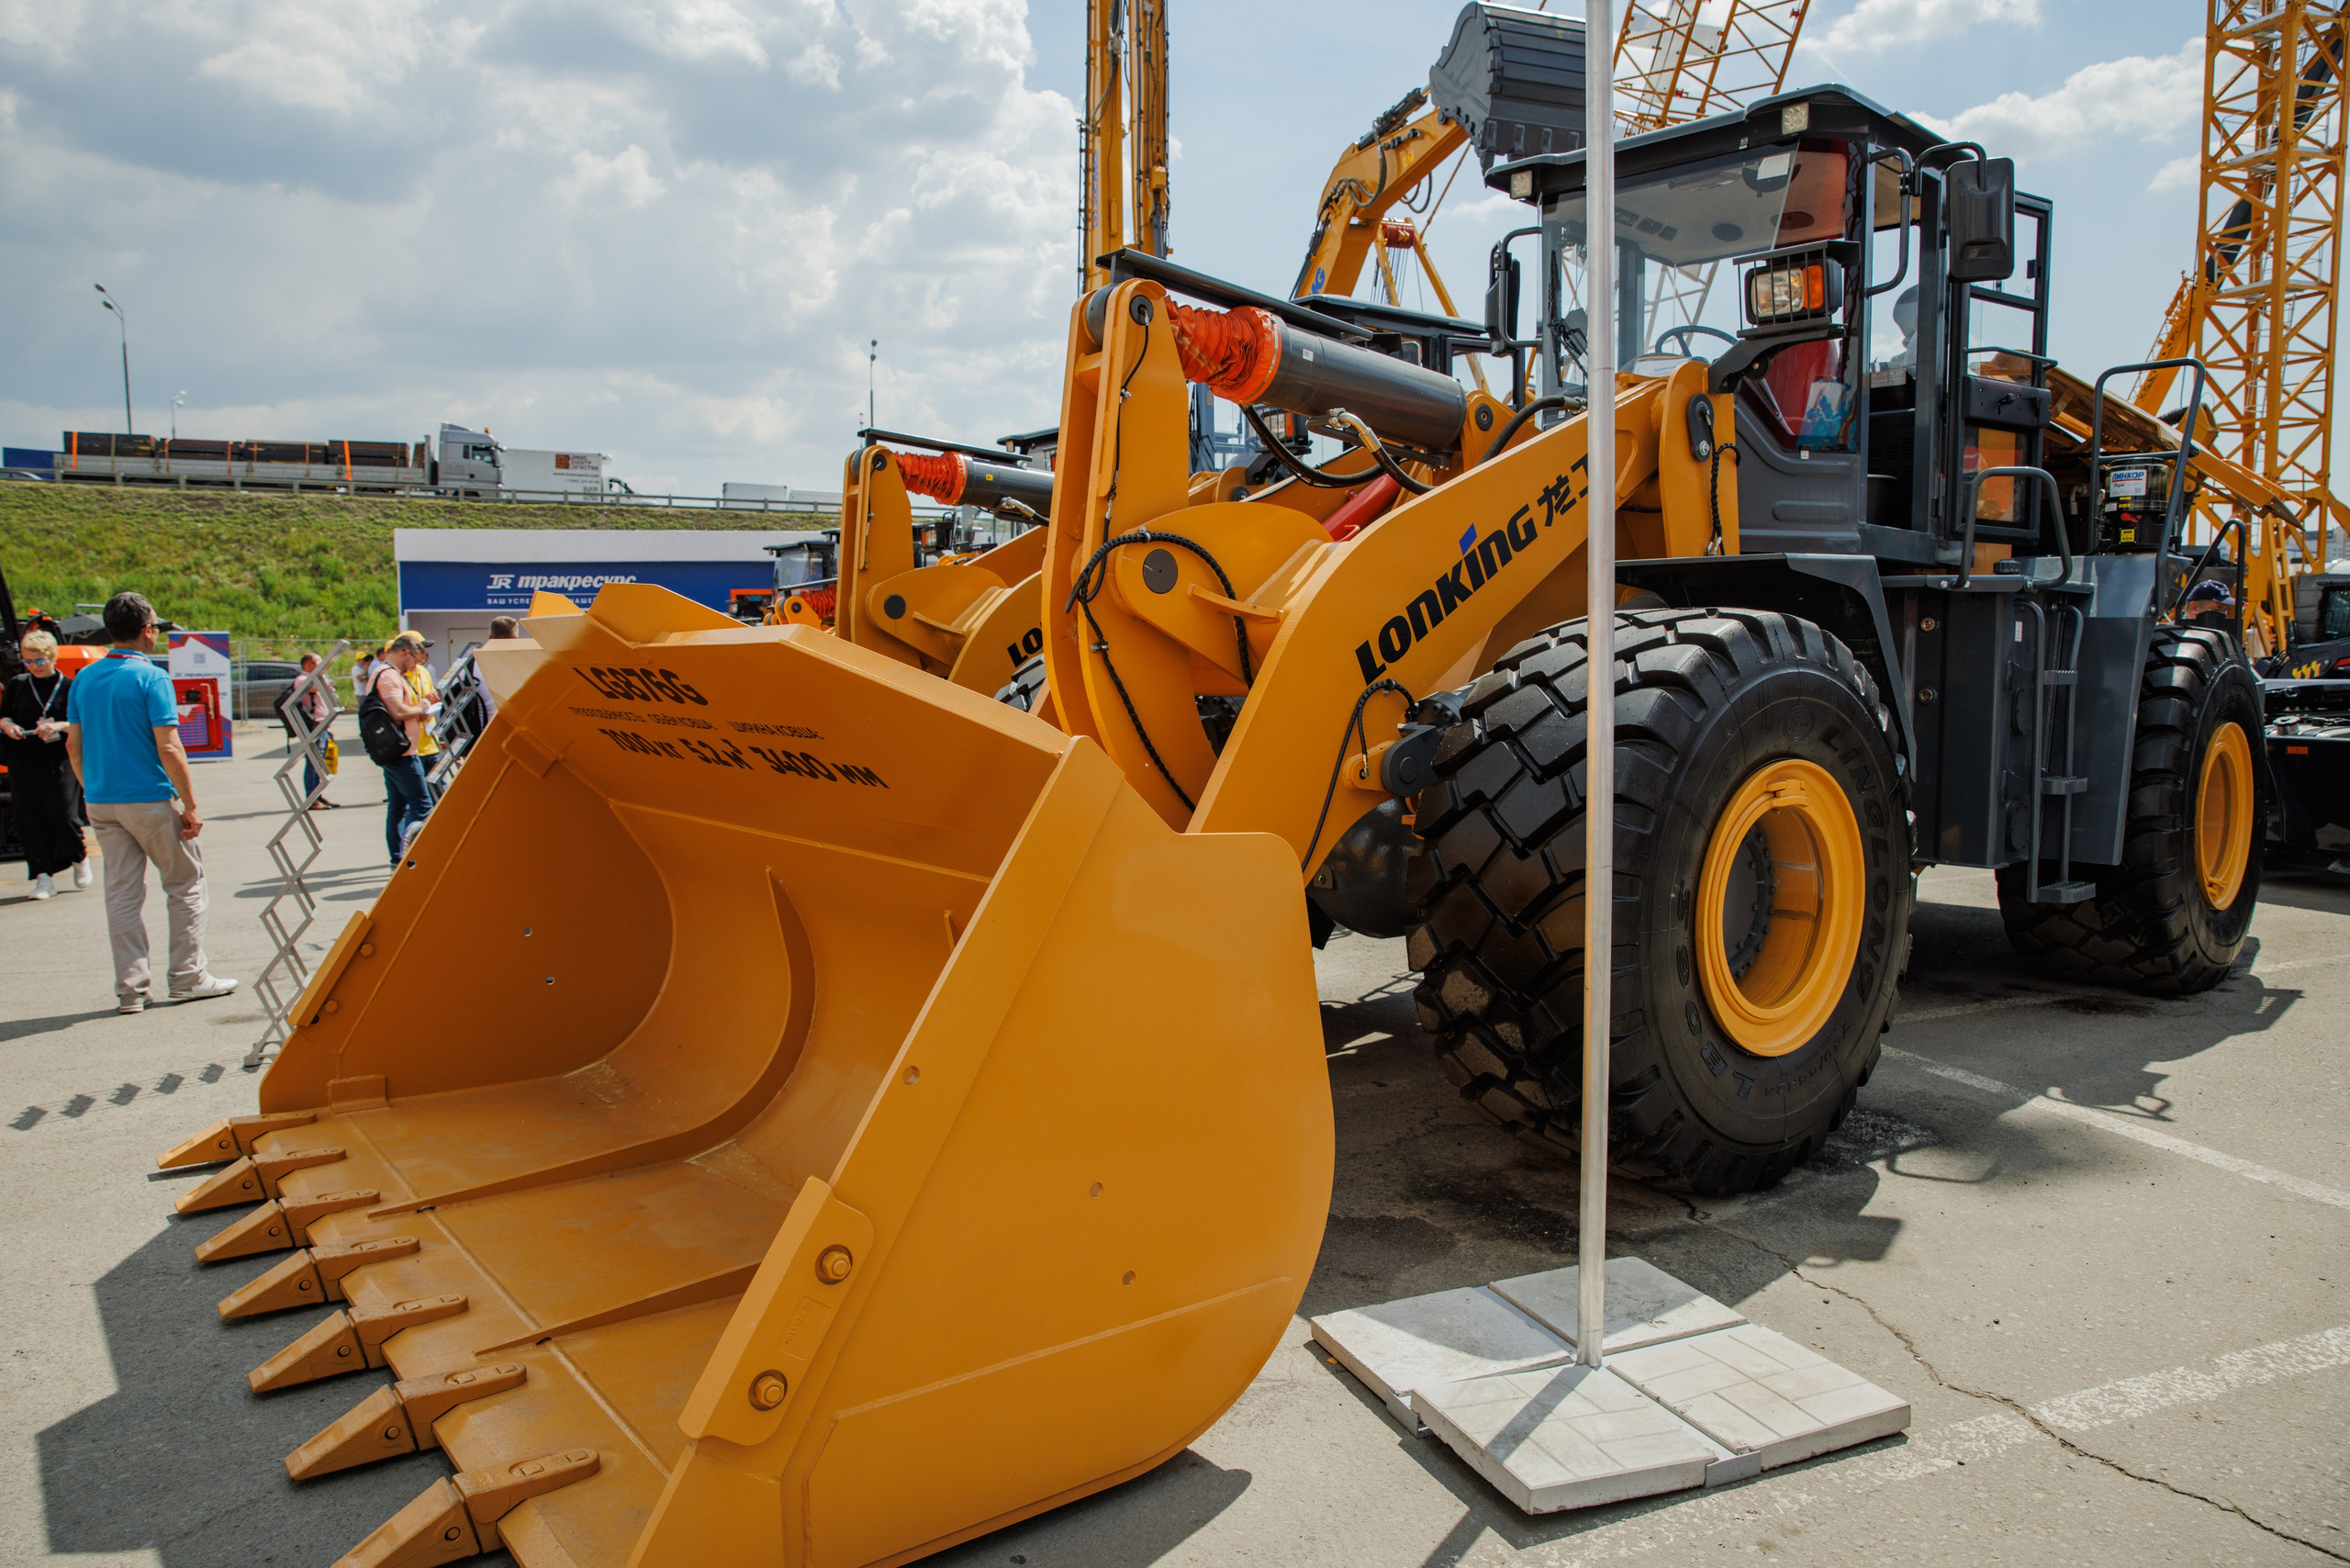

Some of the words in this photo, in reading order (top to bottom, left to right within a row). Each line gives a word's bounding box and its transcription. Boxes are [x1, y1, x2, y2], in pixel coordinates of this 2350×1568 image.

[2111, 471, 2144, 481] ЛИНКОР
[570, 597, 596, 605] АШЕ
[1007, 621, 1044, 668] LO
[572, 666, 709, 706] LG876G
[726, 720, 777, 736] ШИРИНА
[772, 724, 825, 741] КОВША:
[598, 728, 663, 756] 7000
[652, 740, 686, 760] кг
[747, 745, 838, 782] 3400
[829, 762, 890, 790] мм
[1818, 723, 1891, 1005] LINGLONG
